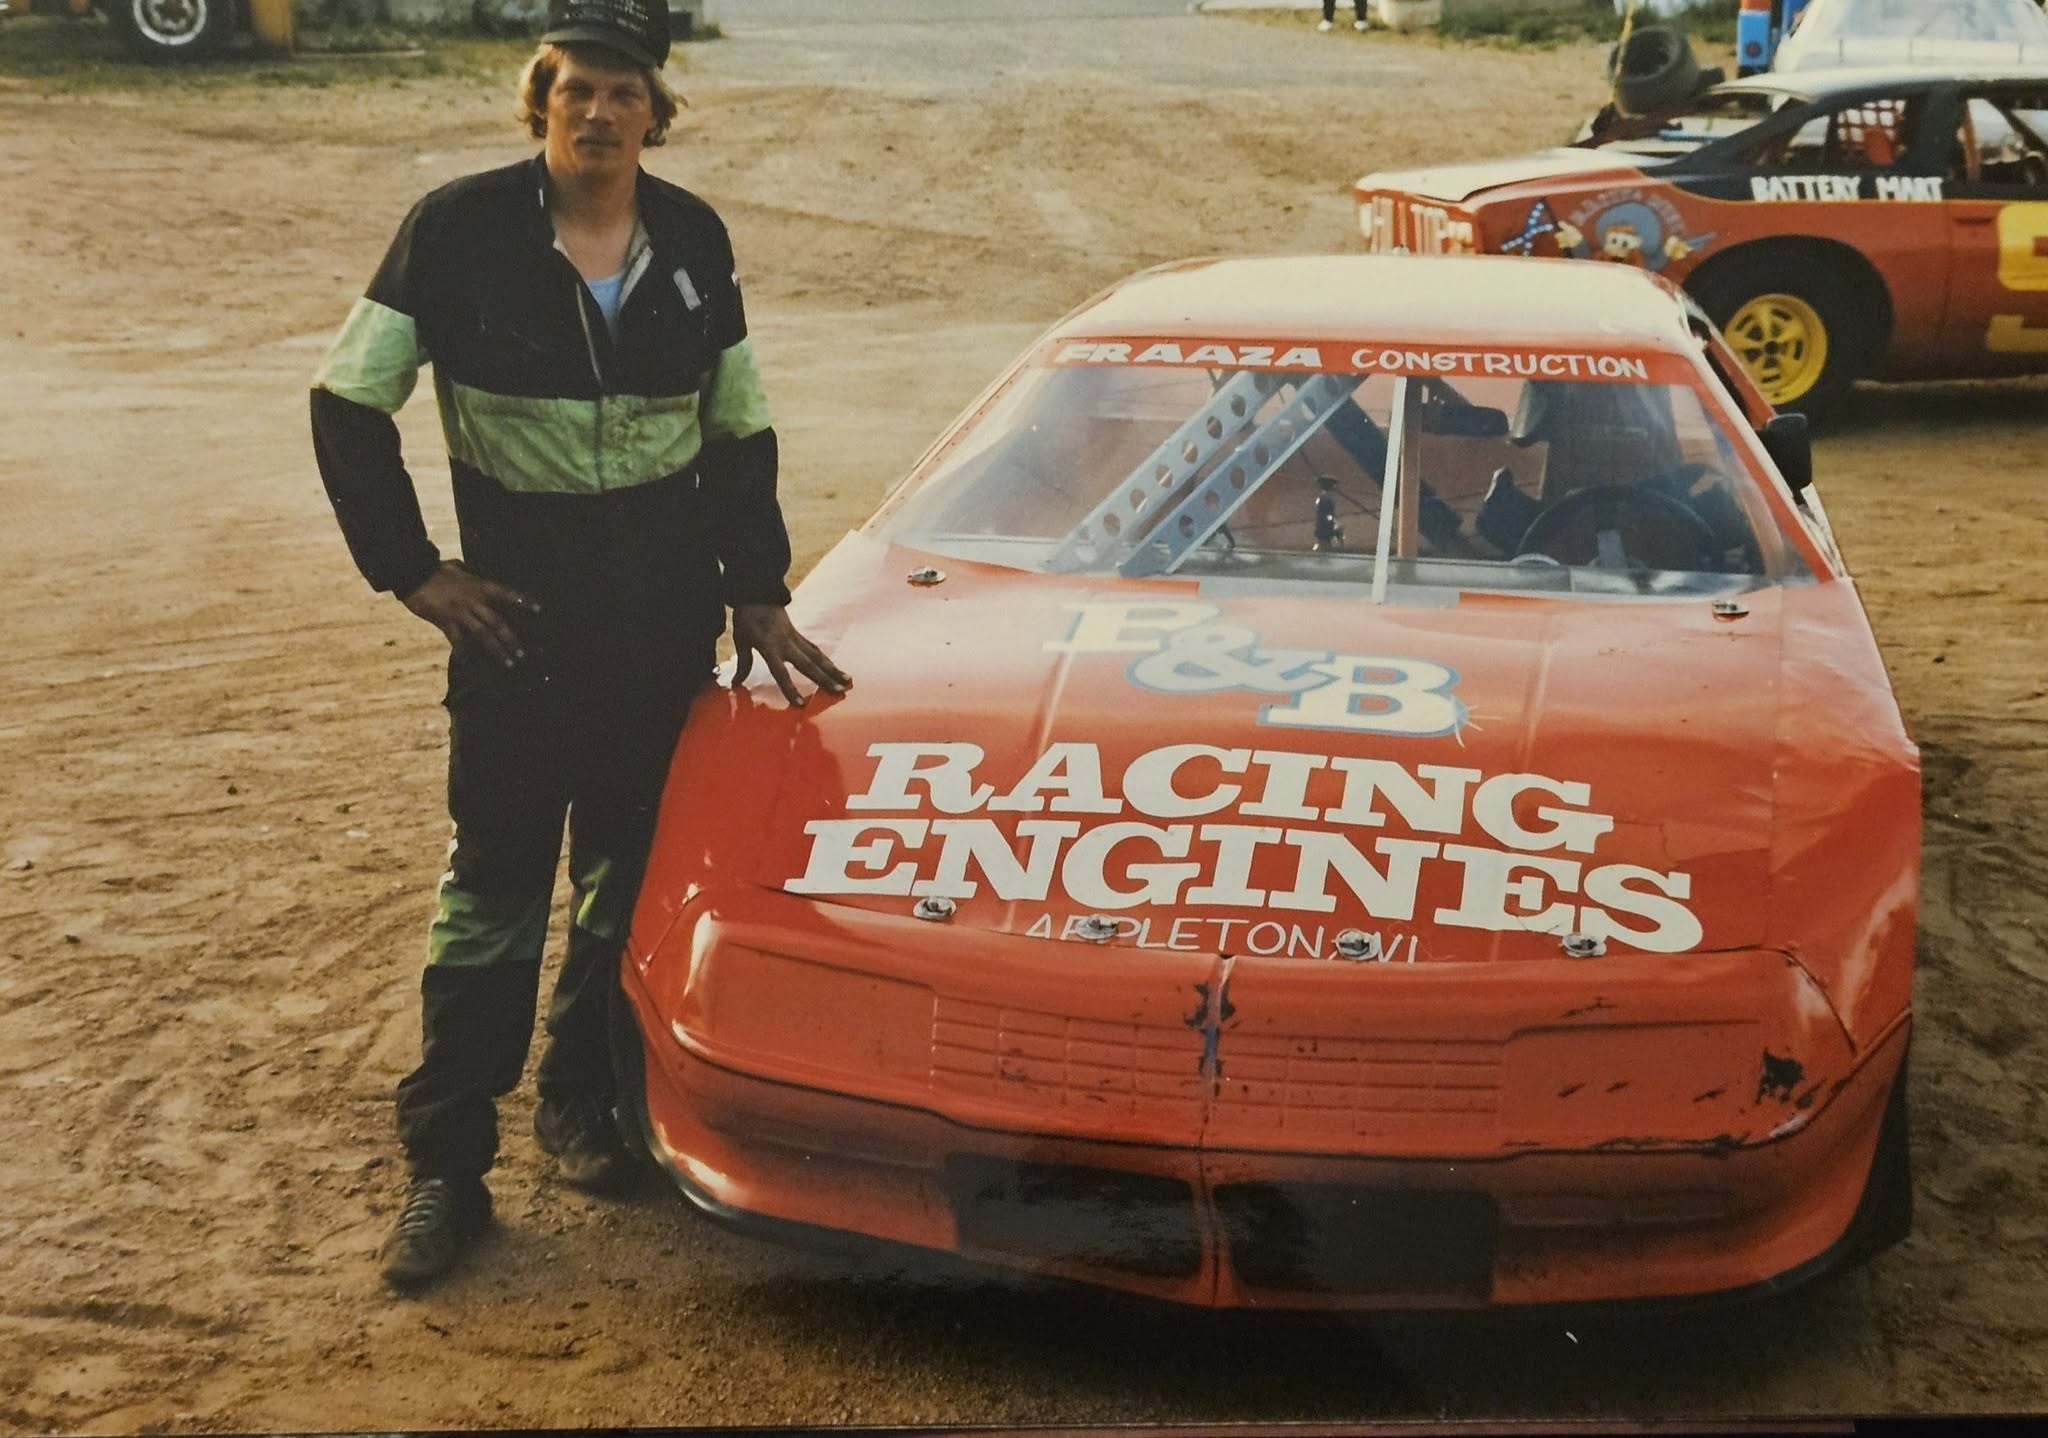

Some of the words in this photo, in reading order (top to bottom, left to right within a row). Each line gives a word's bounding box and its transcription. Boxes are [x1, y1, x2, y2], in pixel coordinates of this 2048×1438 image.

[1751, 174, 1861, 202] BATTERY
[1875, 176, 1944, 203] MART
[1054, 342, 1323, 368] FRAAZA
[1351, 348, 1649, 380] CONSTRUCTION
[845, 741, 1616, 855] RACING
[783, 819, 1705, 954] ENGINES
